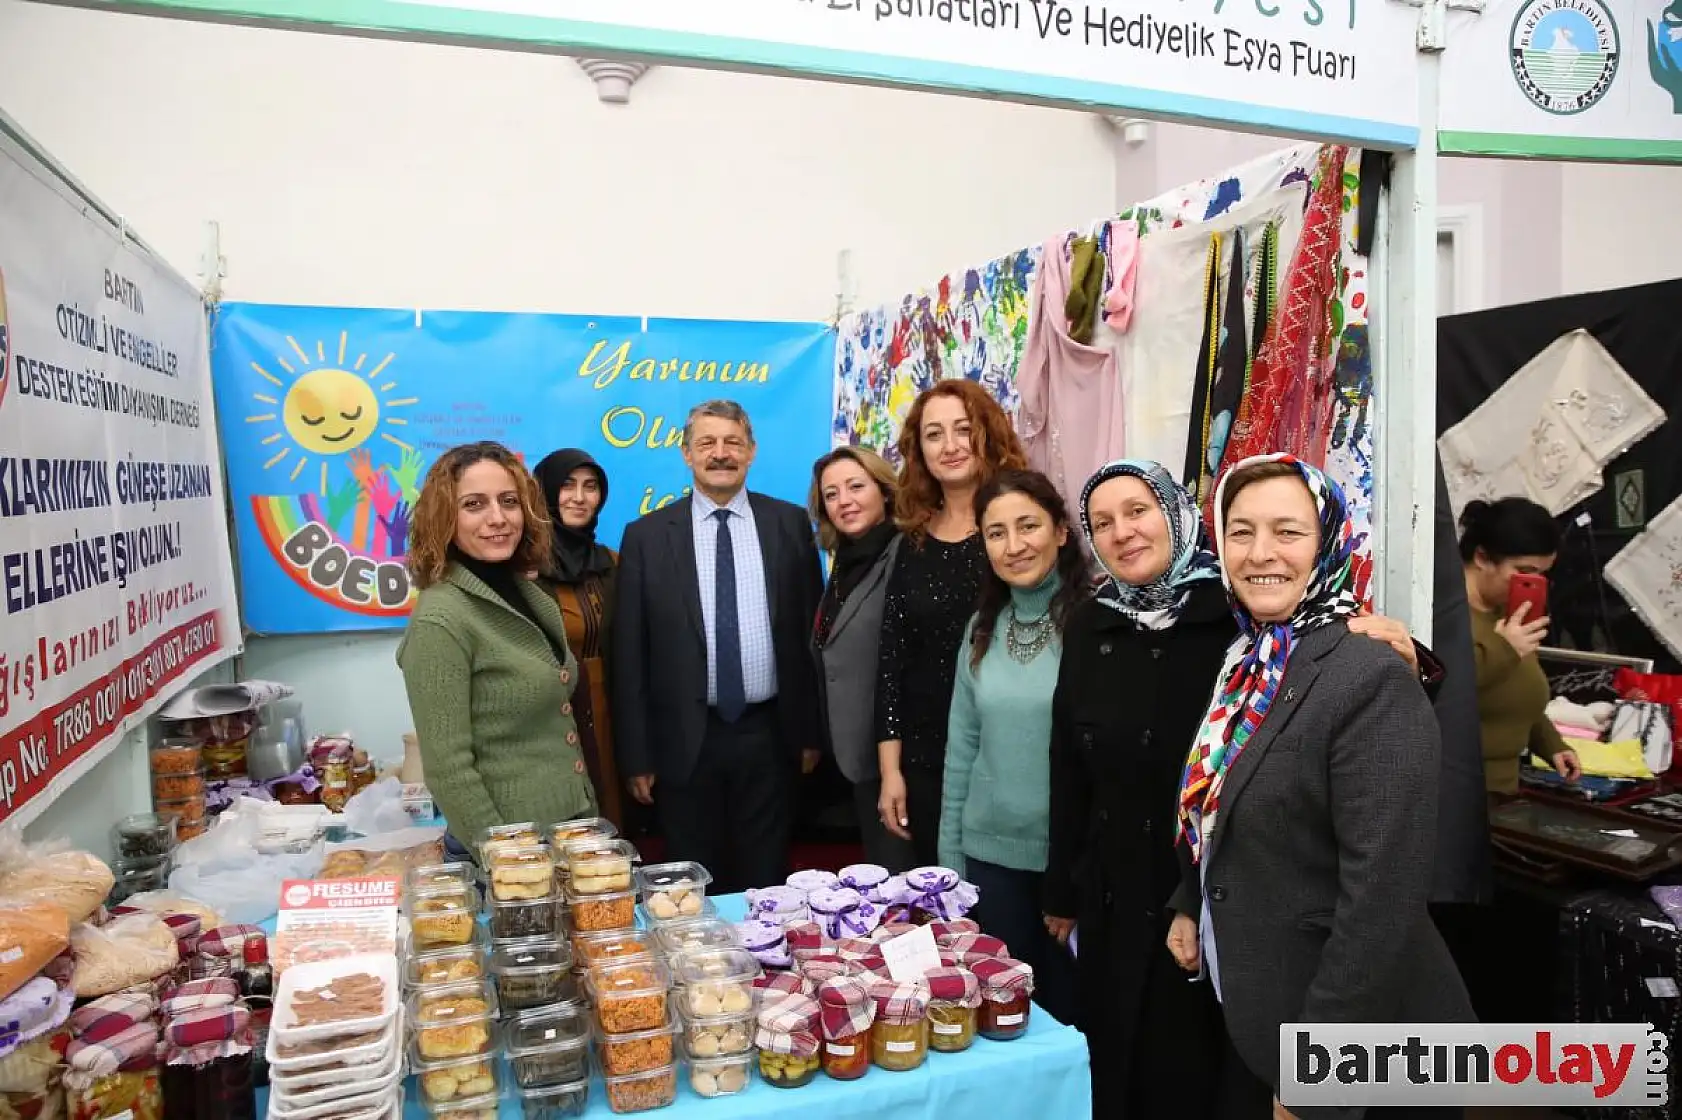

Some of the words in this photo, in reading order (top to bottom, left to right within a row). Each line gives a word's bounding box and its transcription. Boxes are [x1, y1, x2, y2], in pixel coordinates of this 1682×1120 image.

[1030, 0, 1072, 38] Ve
[1084, 5, 1215, 58] Hediyelik
[1223, 28, 1281, 72] Eşya
[1289, 41, 1355, 80] Fuarı
[104, 268, 144, 315] BARTIN
[110, 324, 127, 360] VE
[16, 354, 79, 406] DESTEK
[167, 464, 211, 499] UZANAN
[4, 528, 109, 614] ELLERİNE
[53, 697, 92, 756] TR86
